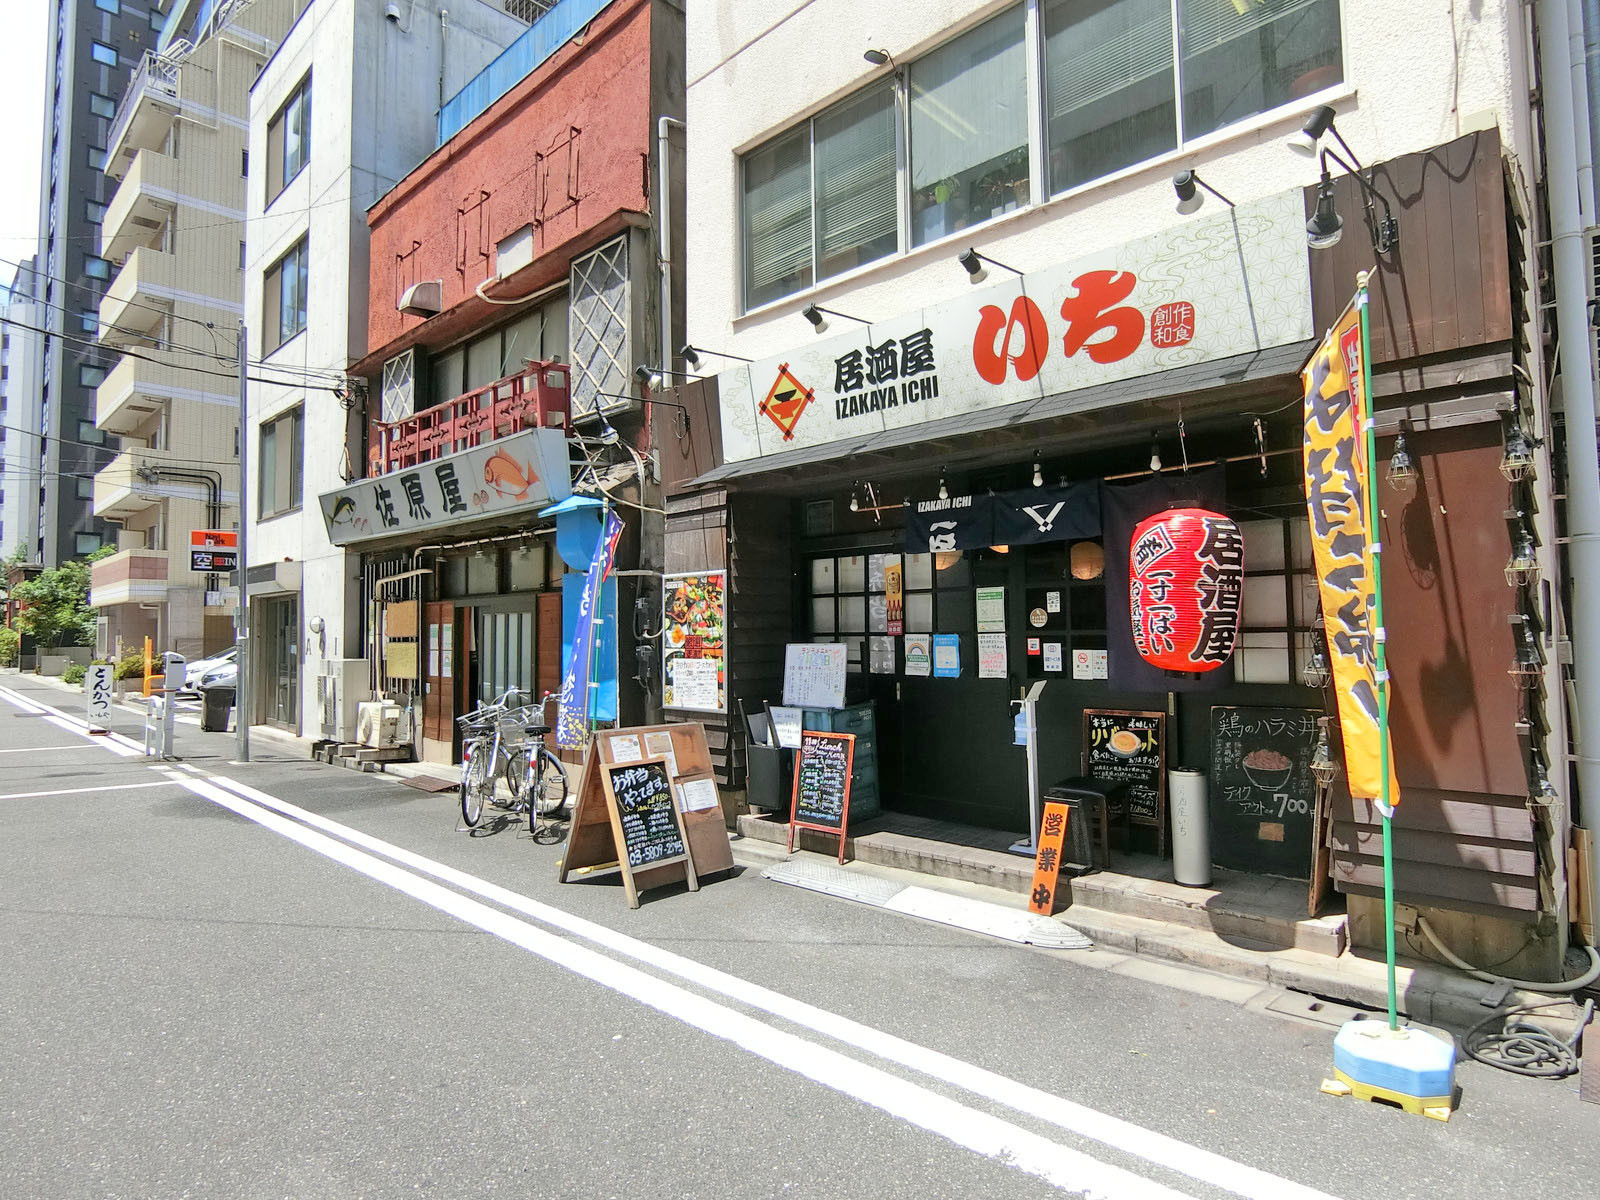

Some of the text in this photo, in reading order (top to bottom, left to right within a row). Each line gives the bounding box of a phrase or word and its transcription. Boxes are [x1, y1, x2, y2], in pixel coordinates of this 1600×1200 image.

[973, 270, 1145, 386] いち
[834, 328, 936, 394] 居酒屋
[836, 375, 939, 420] IZAKAYA ICHI
[374, 463, 467, 528] 佐原屋
[918, 496, 972, 512] IZAKAYA ICHI
[193, 553, 213, 569] 空
[1189, 518, 1242, 661] 居酒屋
[1146, 571, 1177, 655] 一寸一ぱい
[93, 667, 110, 709] とんかつ
[1217, 711, 1319, 744] 鶏のハラミ丼
[612, 767, 649, 793] お弁当
[624, 777, 669, 808] やってます。
[1224, 786, 1251, 800] テイク
[1032, 813, 1063, 909] 営業中
